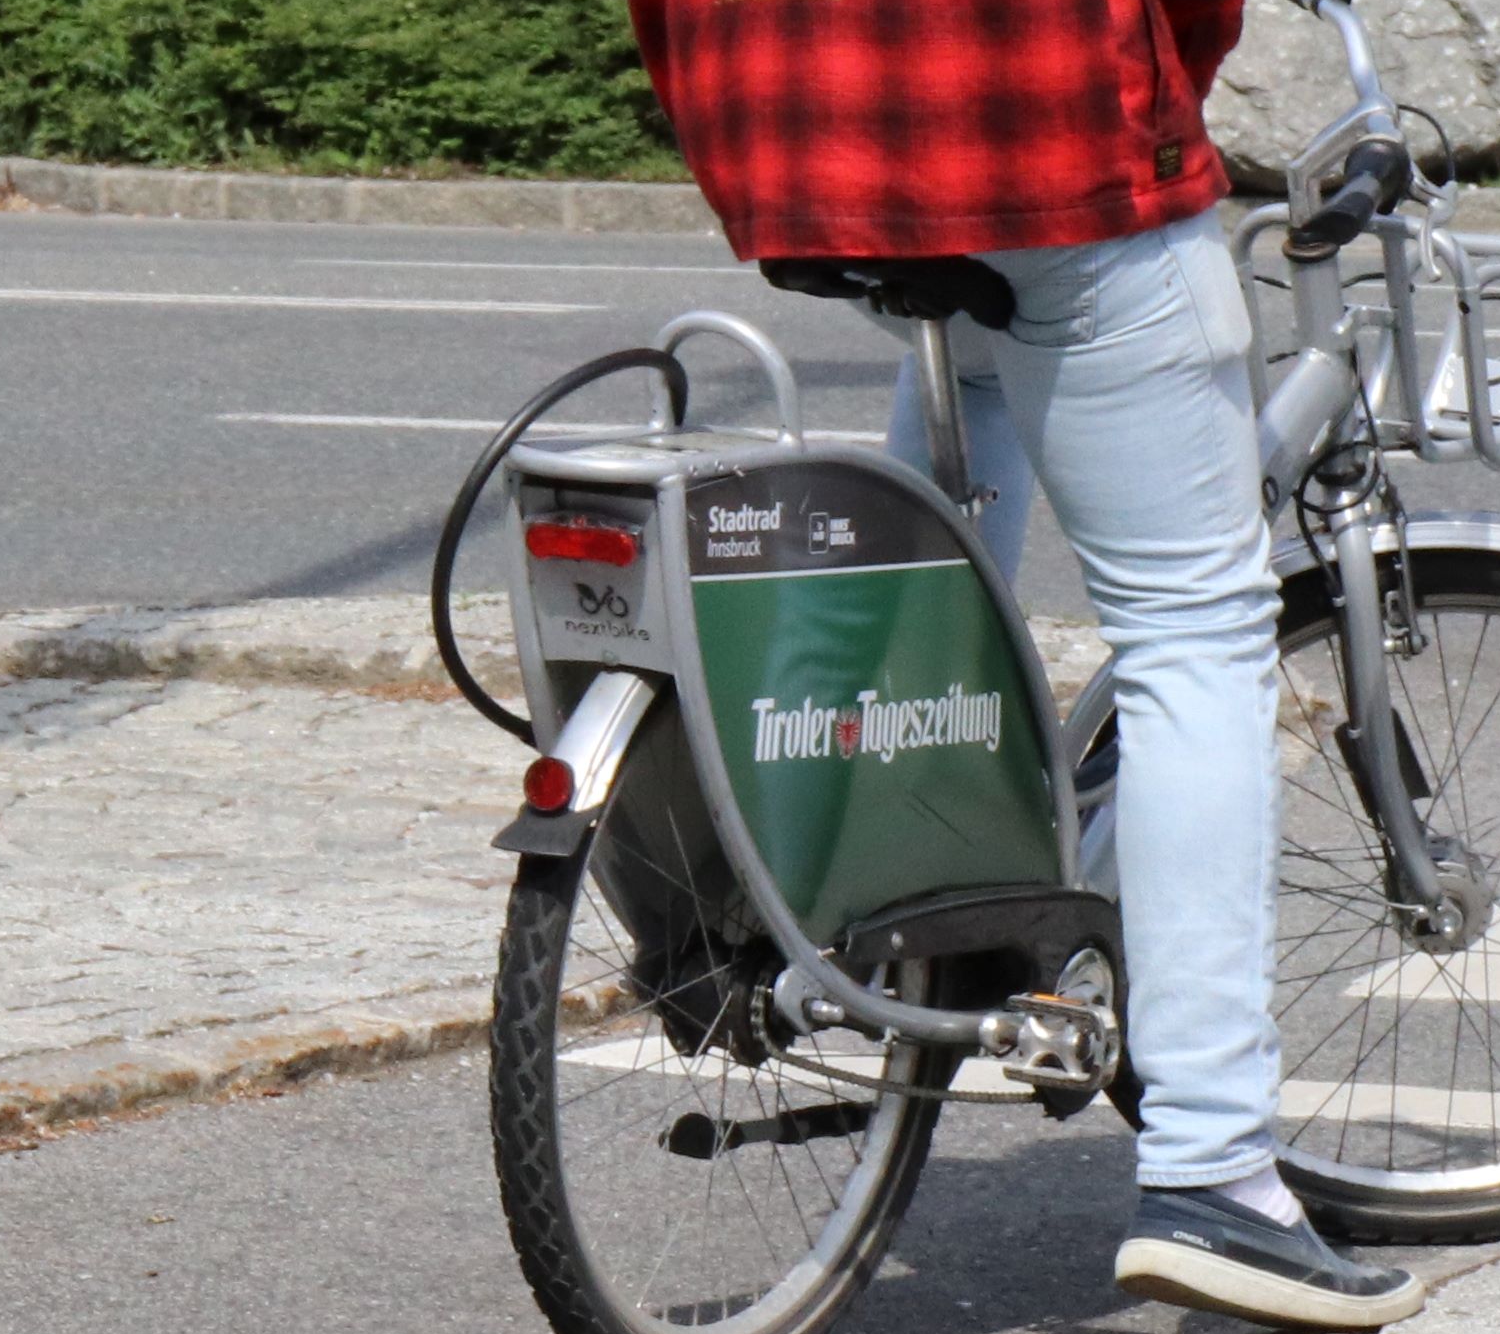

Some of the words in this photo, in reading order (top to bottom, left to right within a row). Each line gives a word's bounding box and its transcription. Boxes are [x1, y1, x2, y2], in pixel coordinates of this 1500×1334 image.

[708, 501, 782, 534] Stadtrad
[706, 535, 762, 558] Innsbruck
[750, 694, 838, 763] Tiroler
[856, 681, 1002, 764] Tageszeitung
